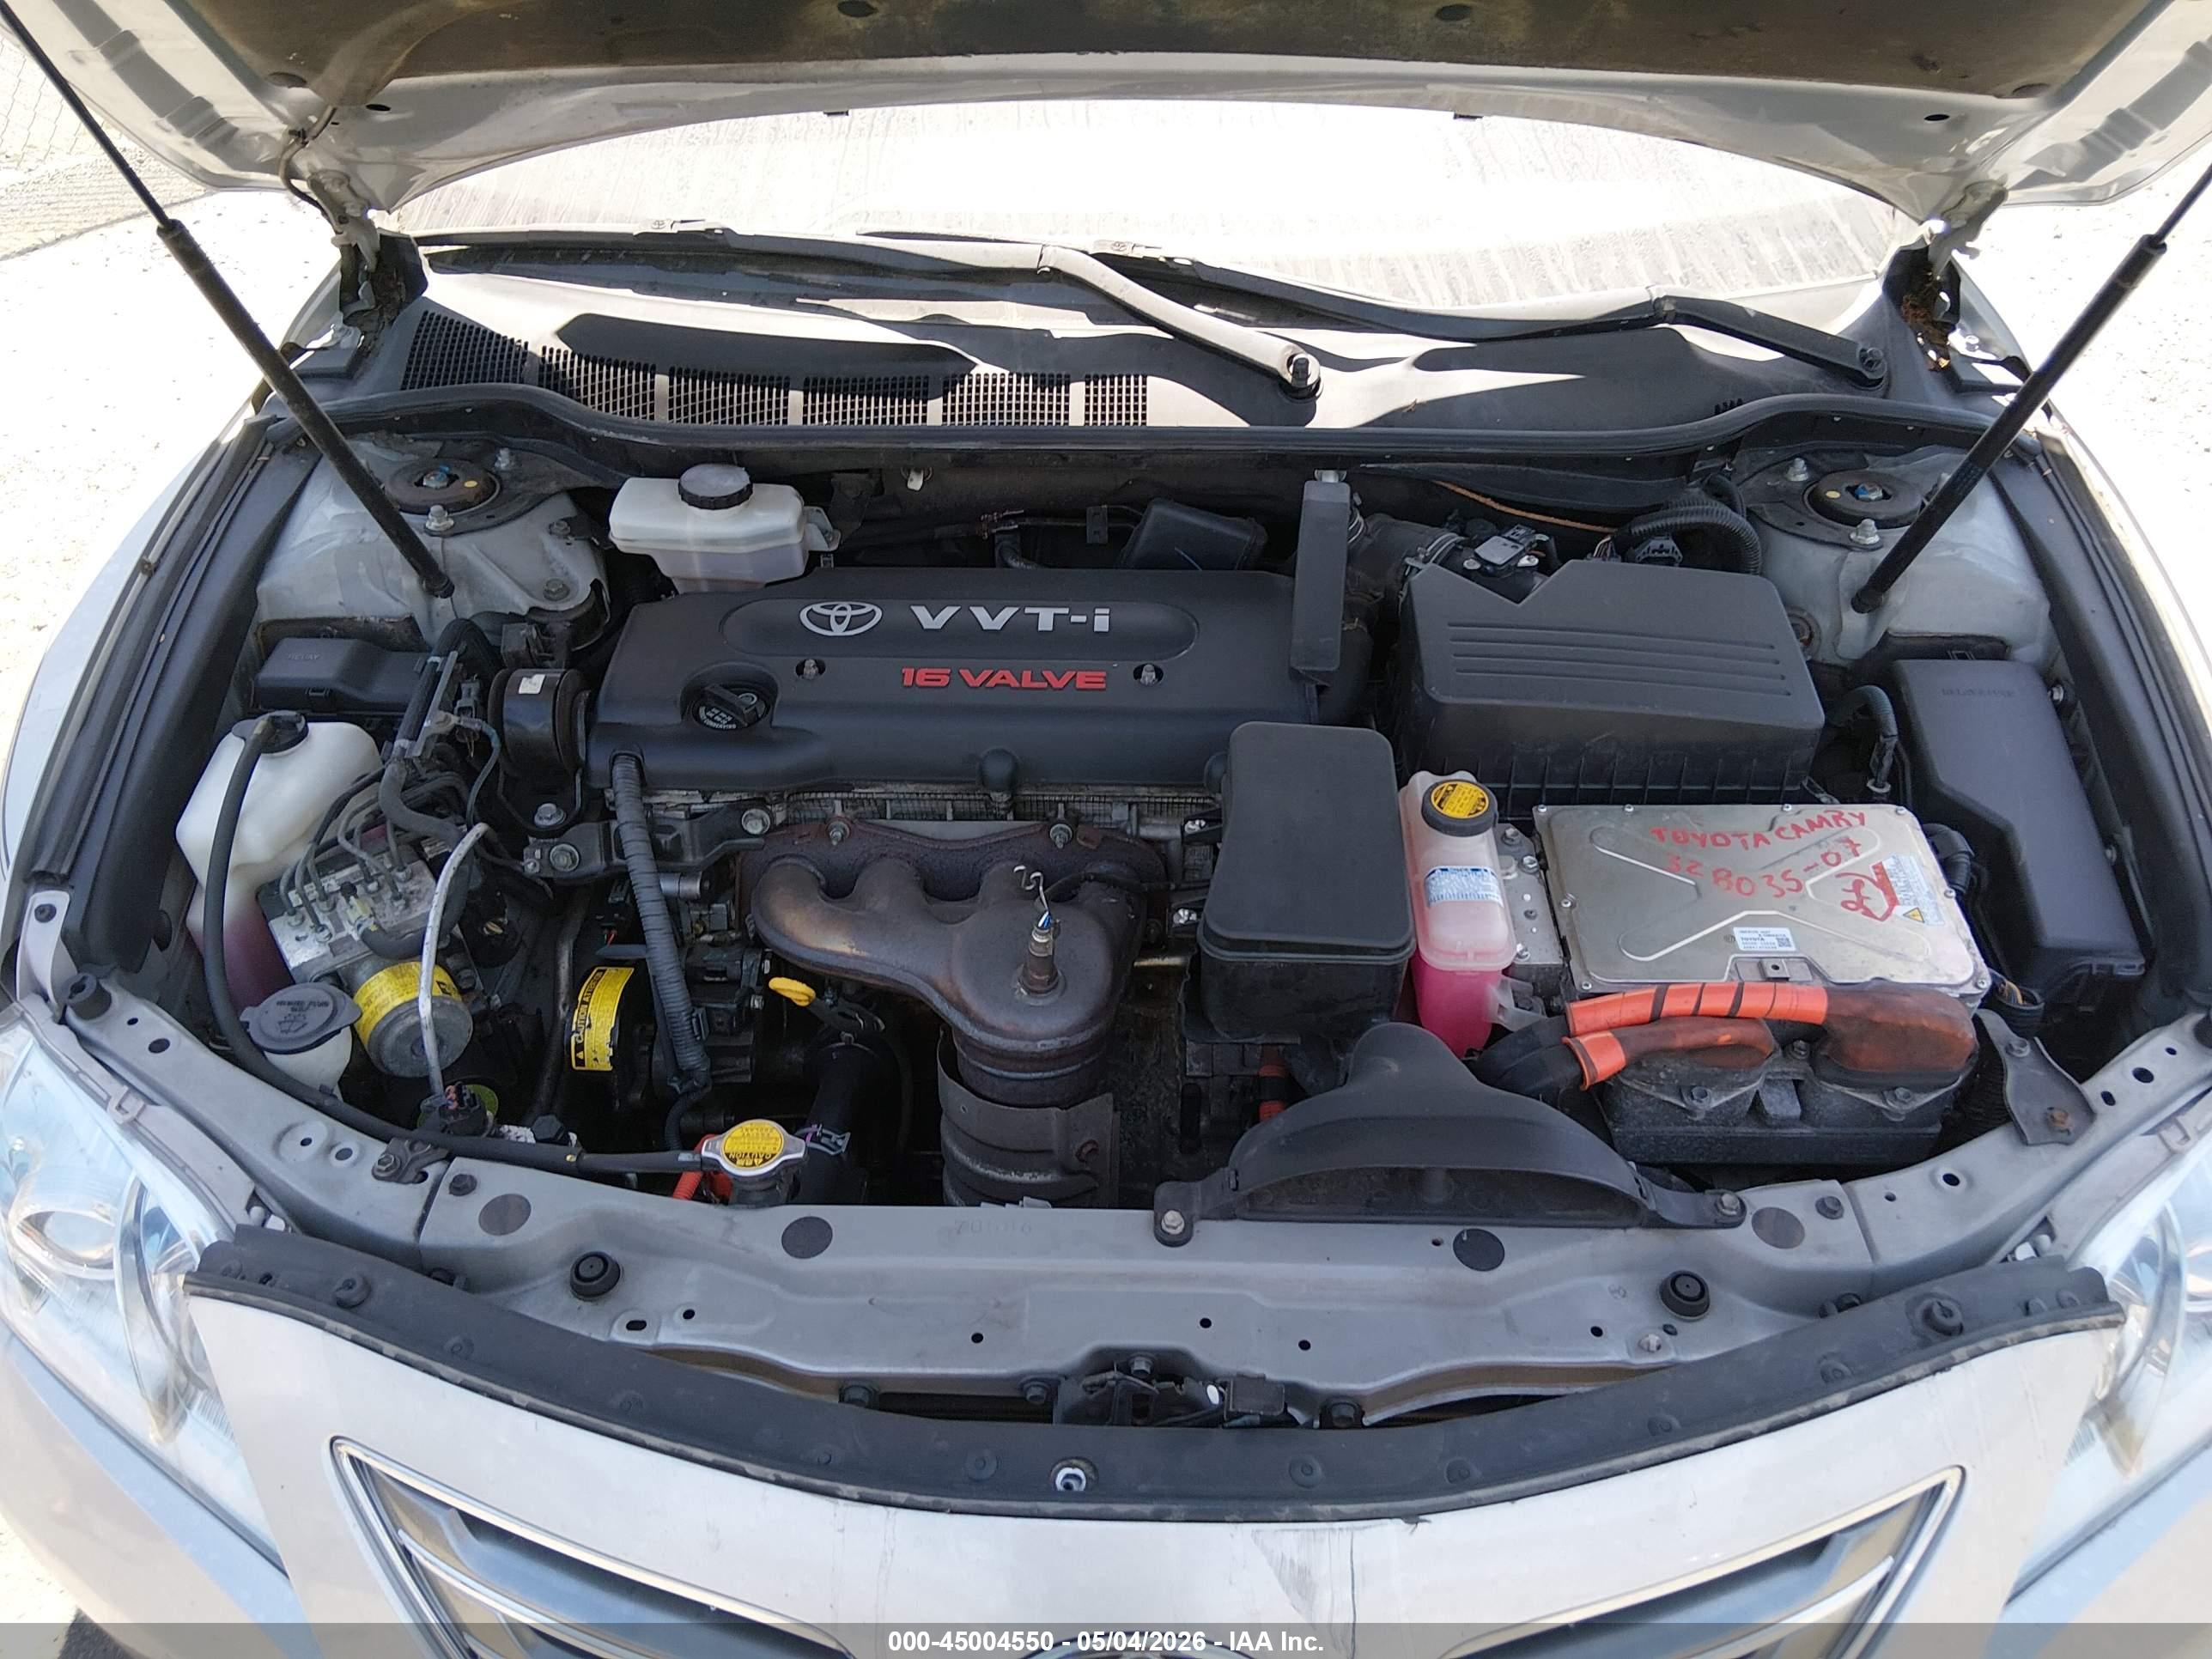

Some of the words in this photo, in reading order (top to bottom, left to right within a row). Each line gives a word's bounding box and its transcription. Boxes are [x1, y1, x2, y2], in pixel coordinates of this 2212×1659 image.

[910, 605, 1110, 632] VVT-i
[902, 668, 951, 687] 16
[959, 669, 1107, 690] VALVE
[1650, 827, 1771, 850] TOYOTA
[1774, 810, 1865, 840] CAMRY
